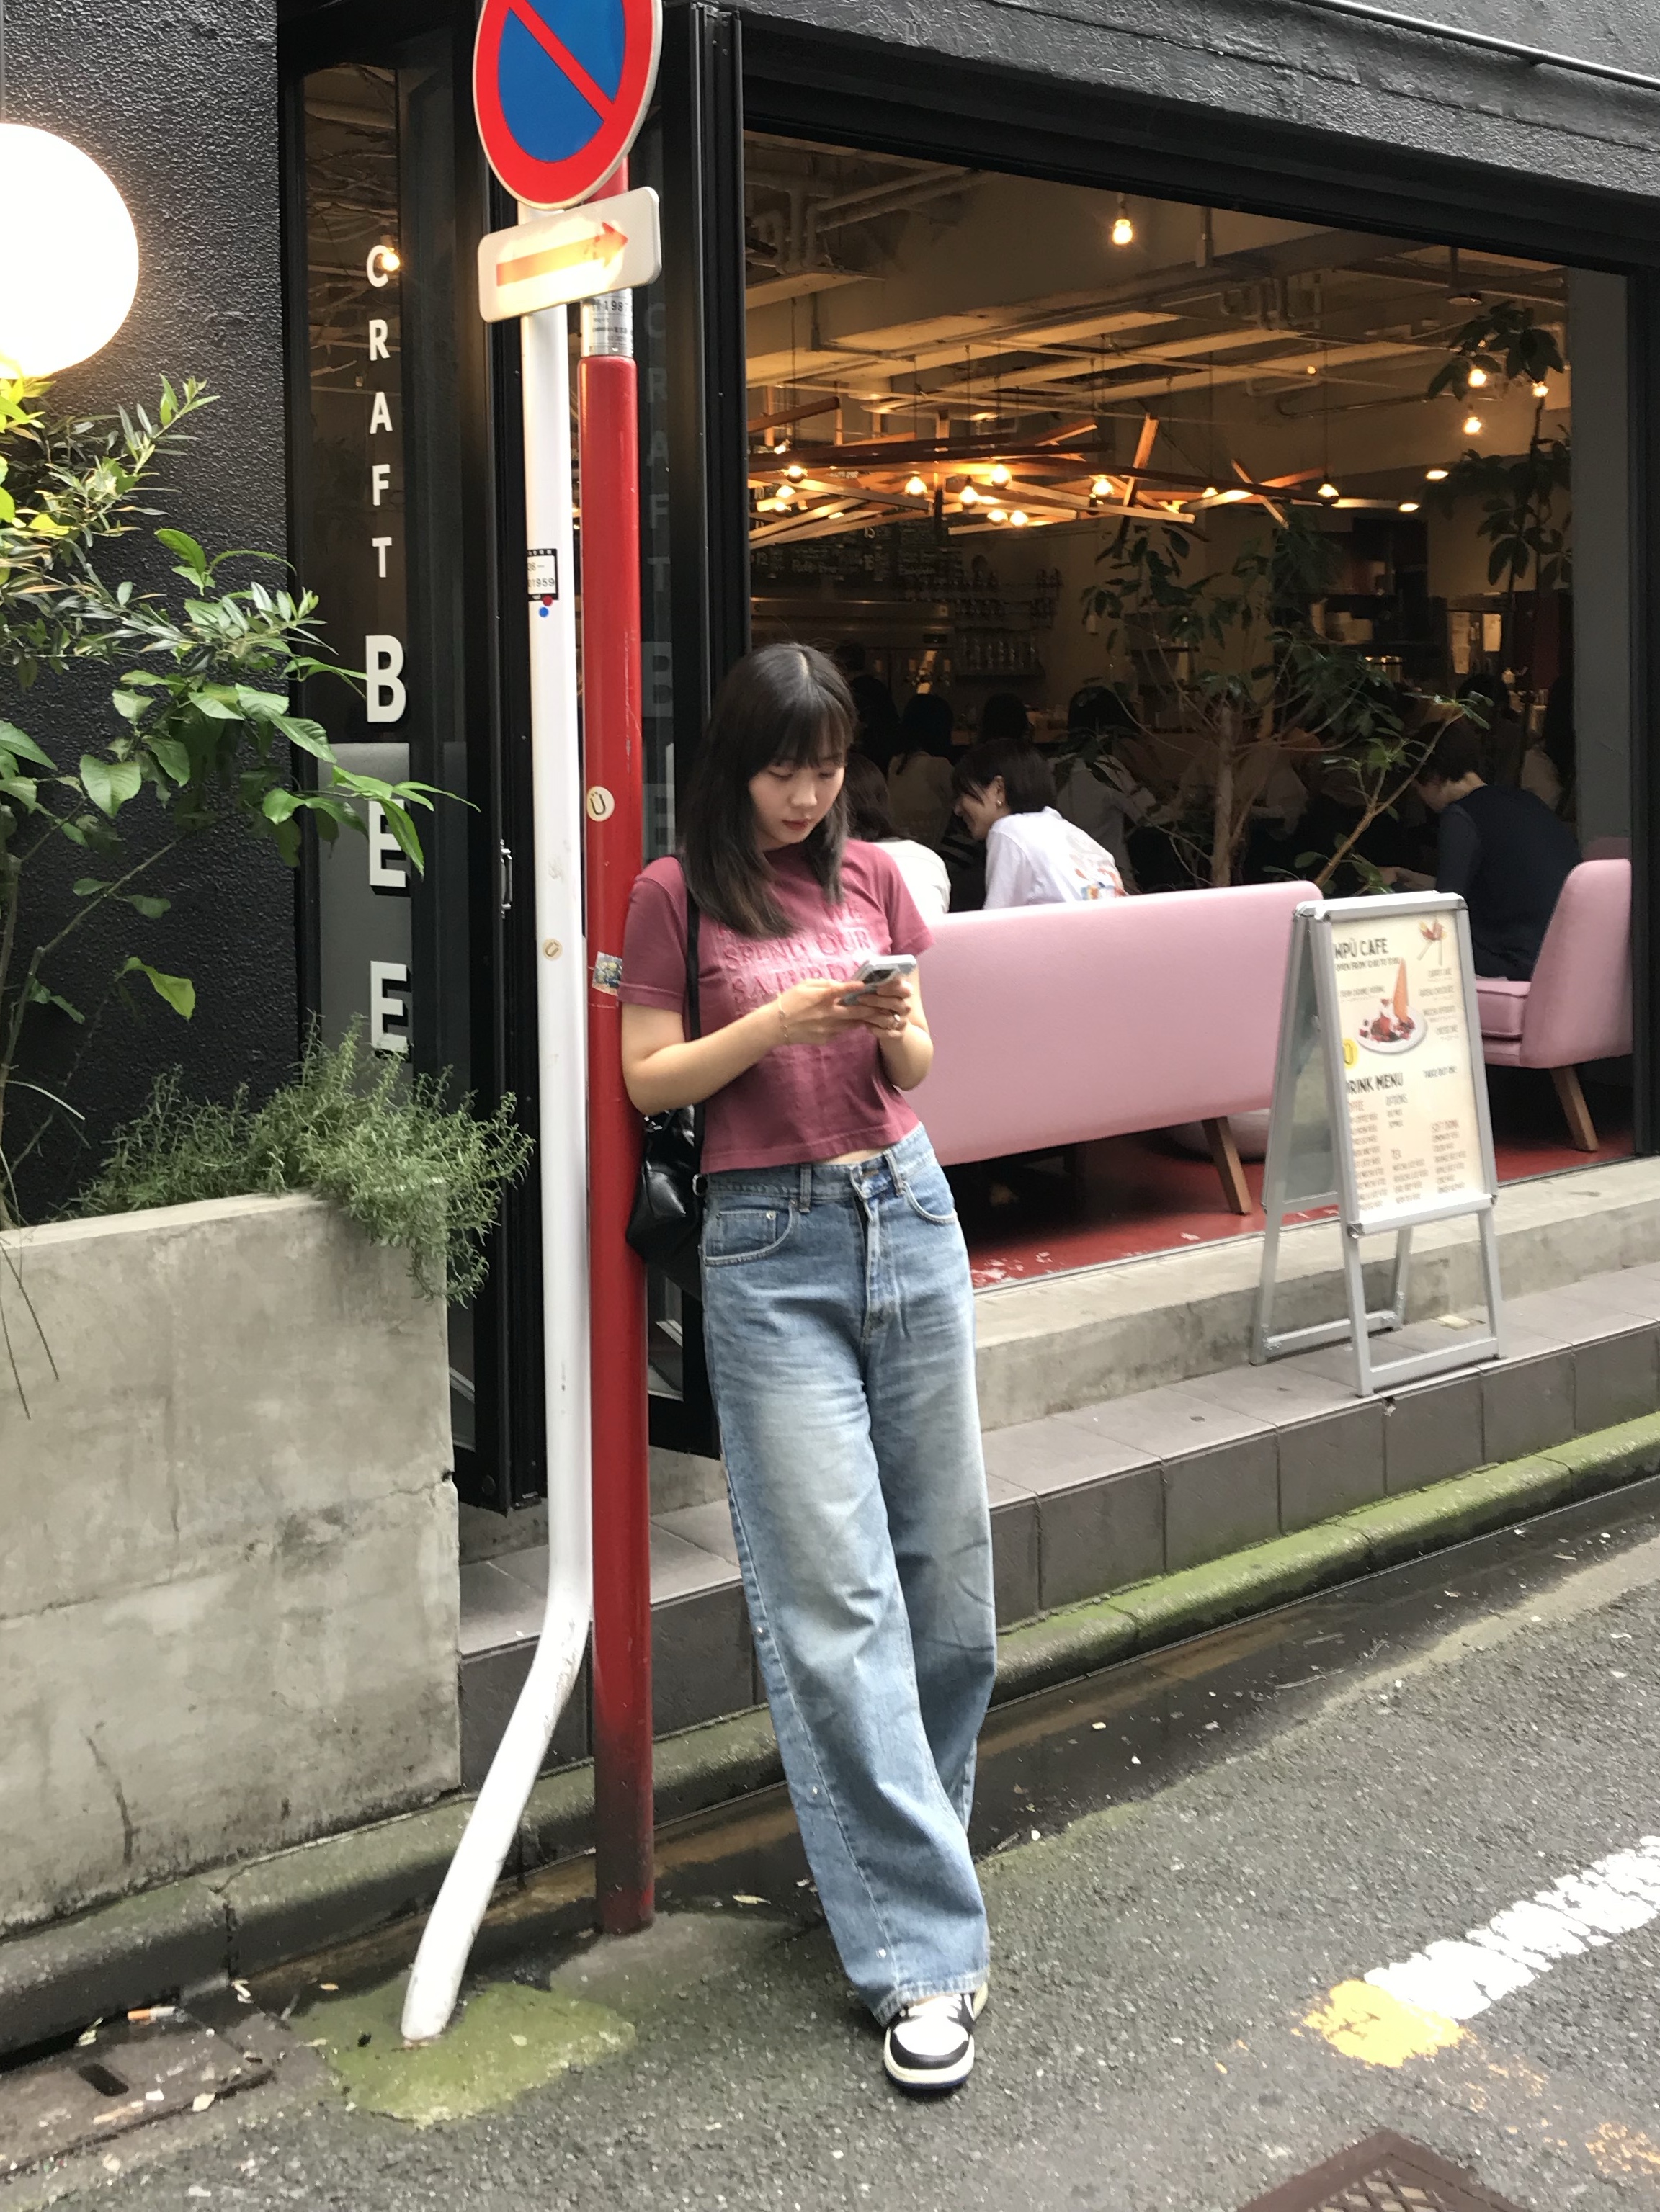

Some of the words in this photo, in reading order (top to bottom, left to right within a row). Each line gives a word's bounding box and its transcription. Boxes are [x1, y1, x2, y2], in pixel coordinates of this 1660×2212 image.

[366, 245, 393, 578] CRAFT
[589, 791, 607, 816] Ü
[815, 930, 871, 956] OUR
[1360, 938, 1389, 957] CAFE
[1375, 1072, 1404, 1091] MENU
